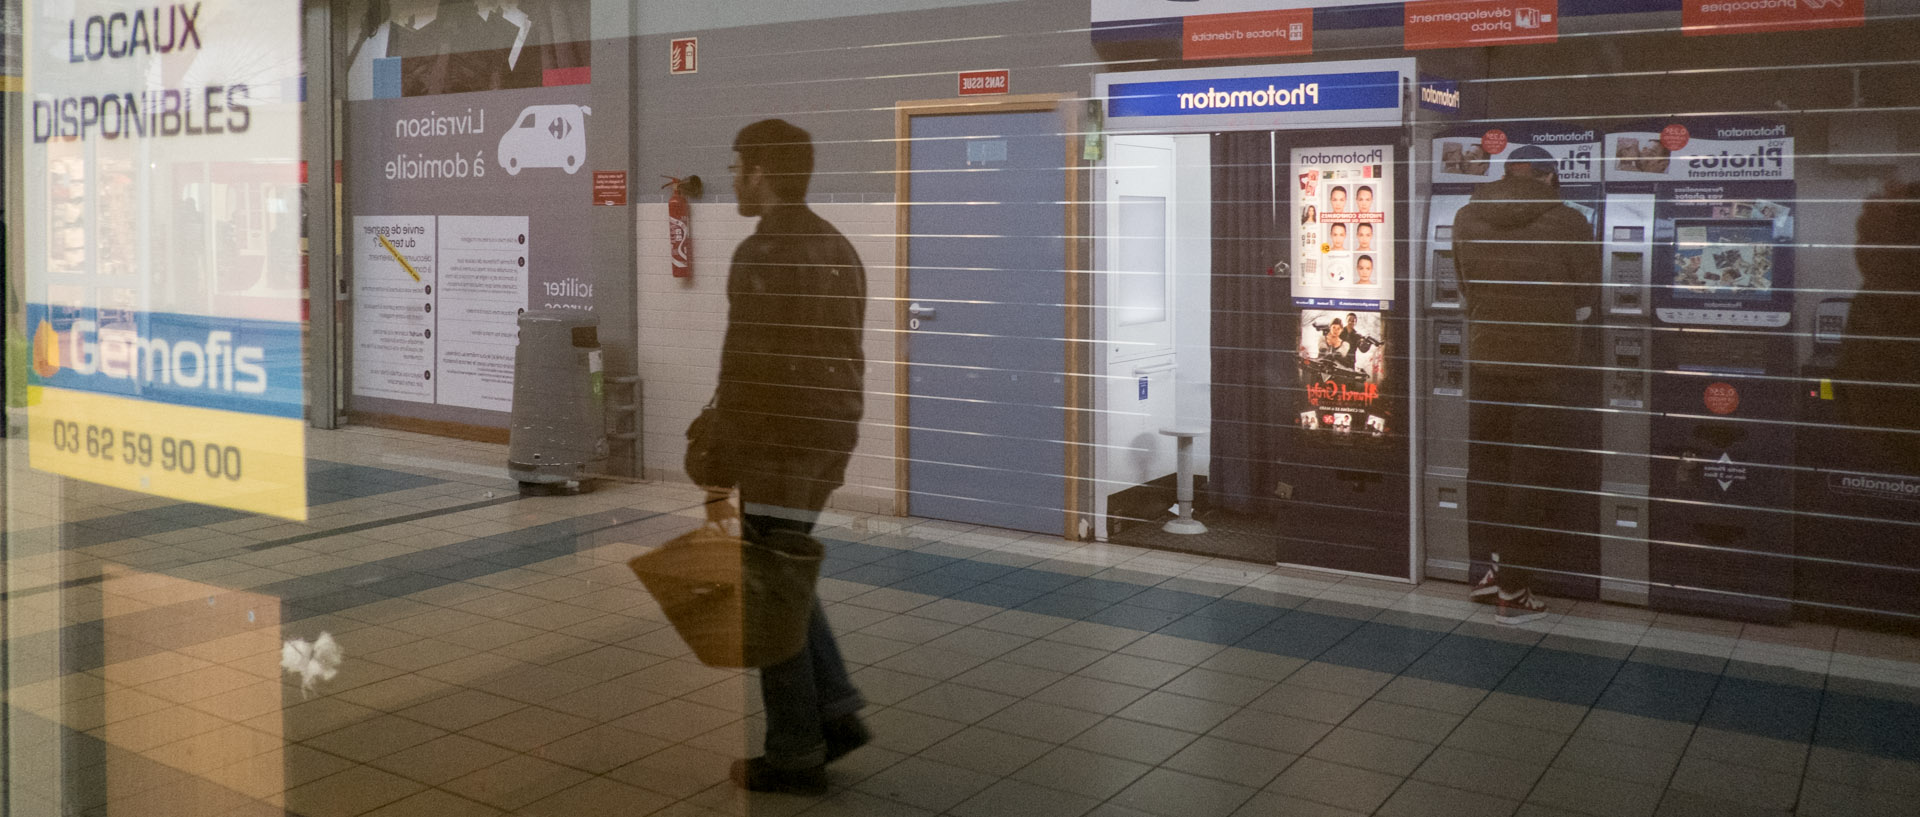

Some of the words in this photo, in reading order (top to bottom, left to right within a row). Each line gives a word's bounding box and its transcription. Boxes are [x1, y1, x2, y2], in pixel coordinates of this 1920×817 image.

[68, 3, 201, 63] LOCAUX
[33, 83, 250, 144] DISPONIBLES
[70, 318, 267, 394] Gemofis
[53, 419, 80, 454] 03
[86, 424, 115, 461] 62
[122, 430, 153, 467] 59
[161, 437, 196, 474] 90
[203, 443, 243, 482] 00
